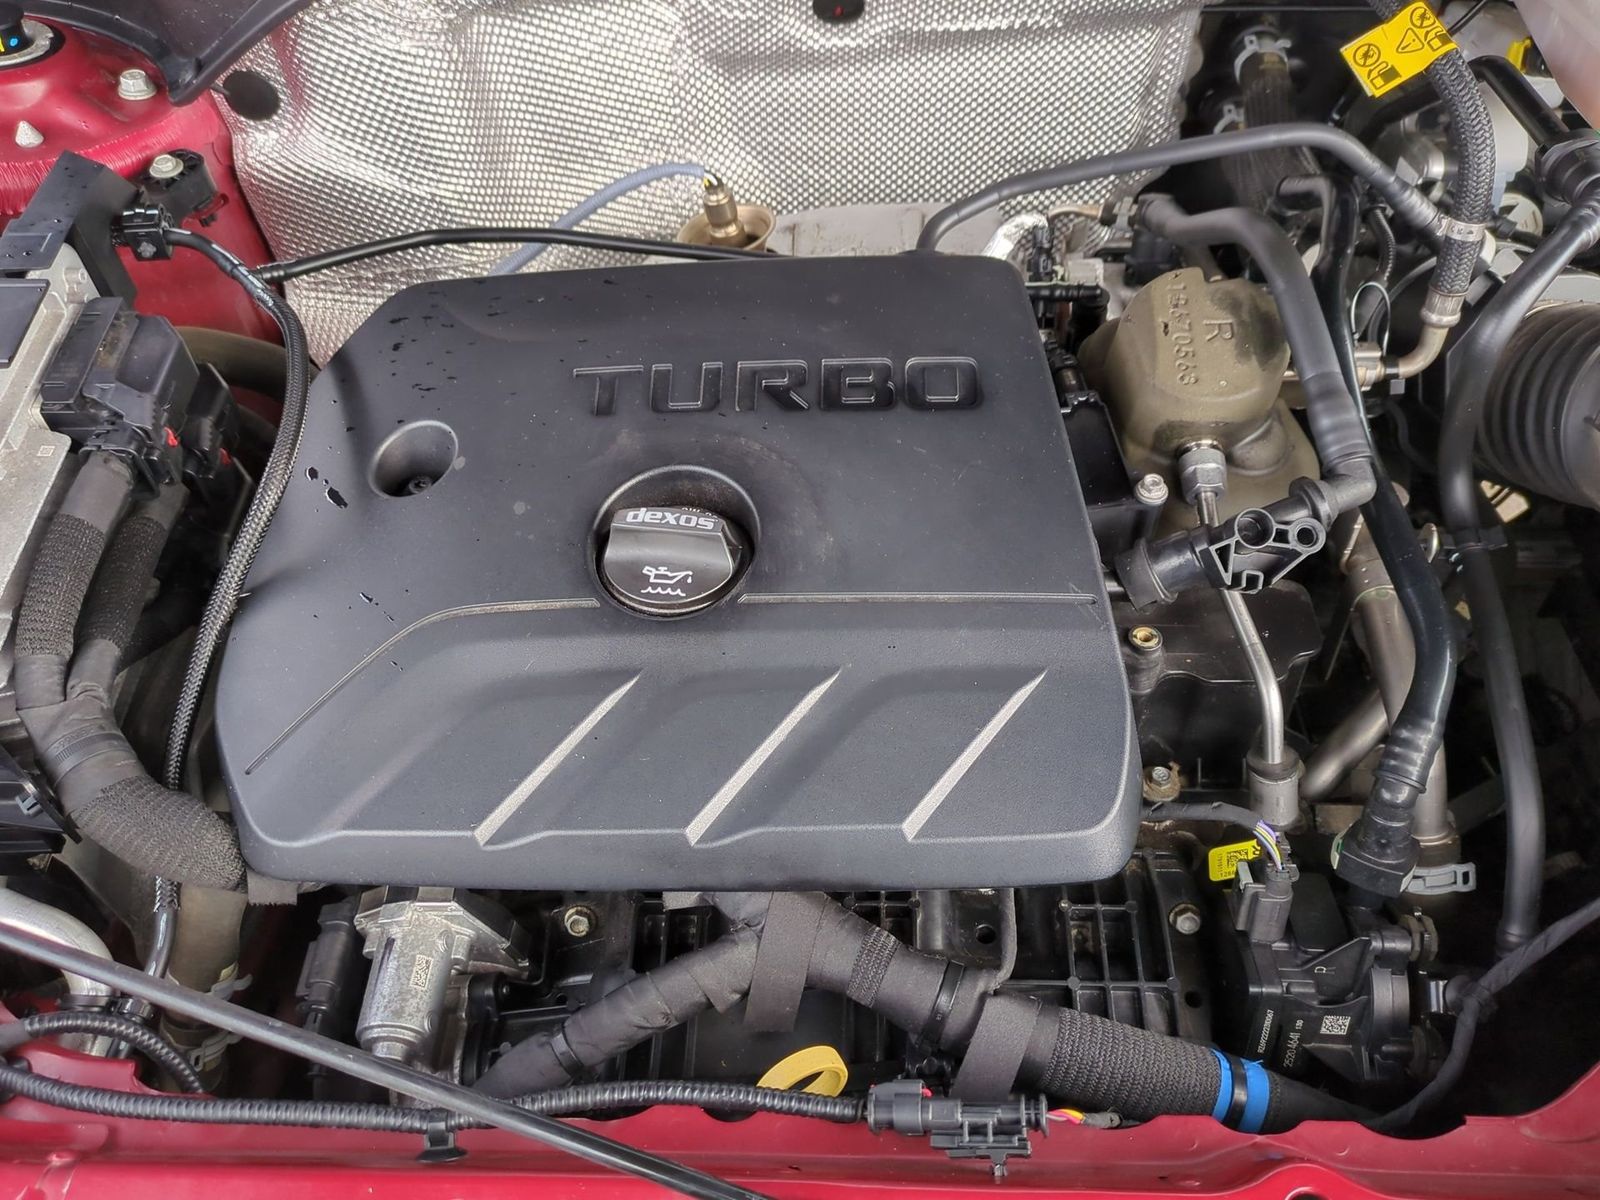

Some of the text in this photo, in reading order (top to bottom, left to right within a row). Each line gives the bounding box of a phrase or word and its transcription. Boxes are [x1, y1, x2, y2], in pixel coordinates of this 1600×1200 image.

[1203, 320, 1233, 342] R
[573, 355, 983, 417] TURBO
[626, 508, 716, 530] dexos
